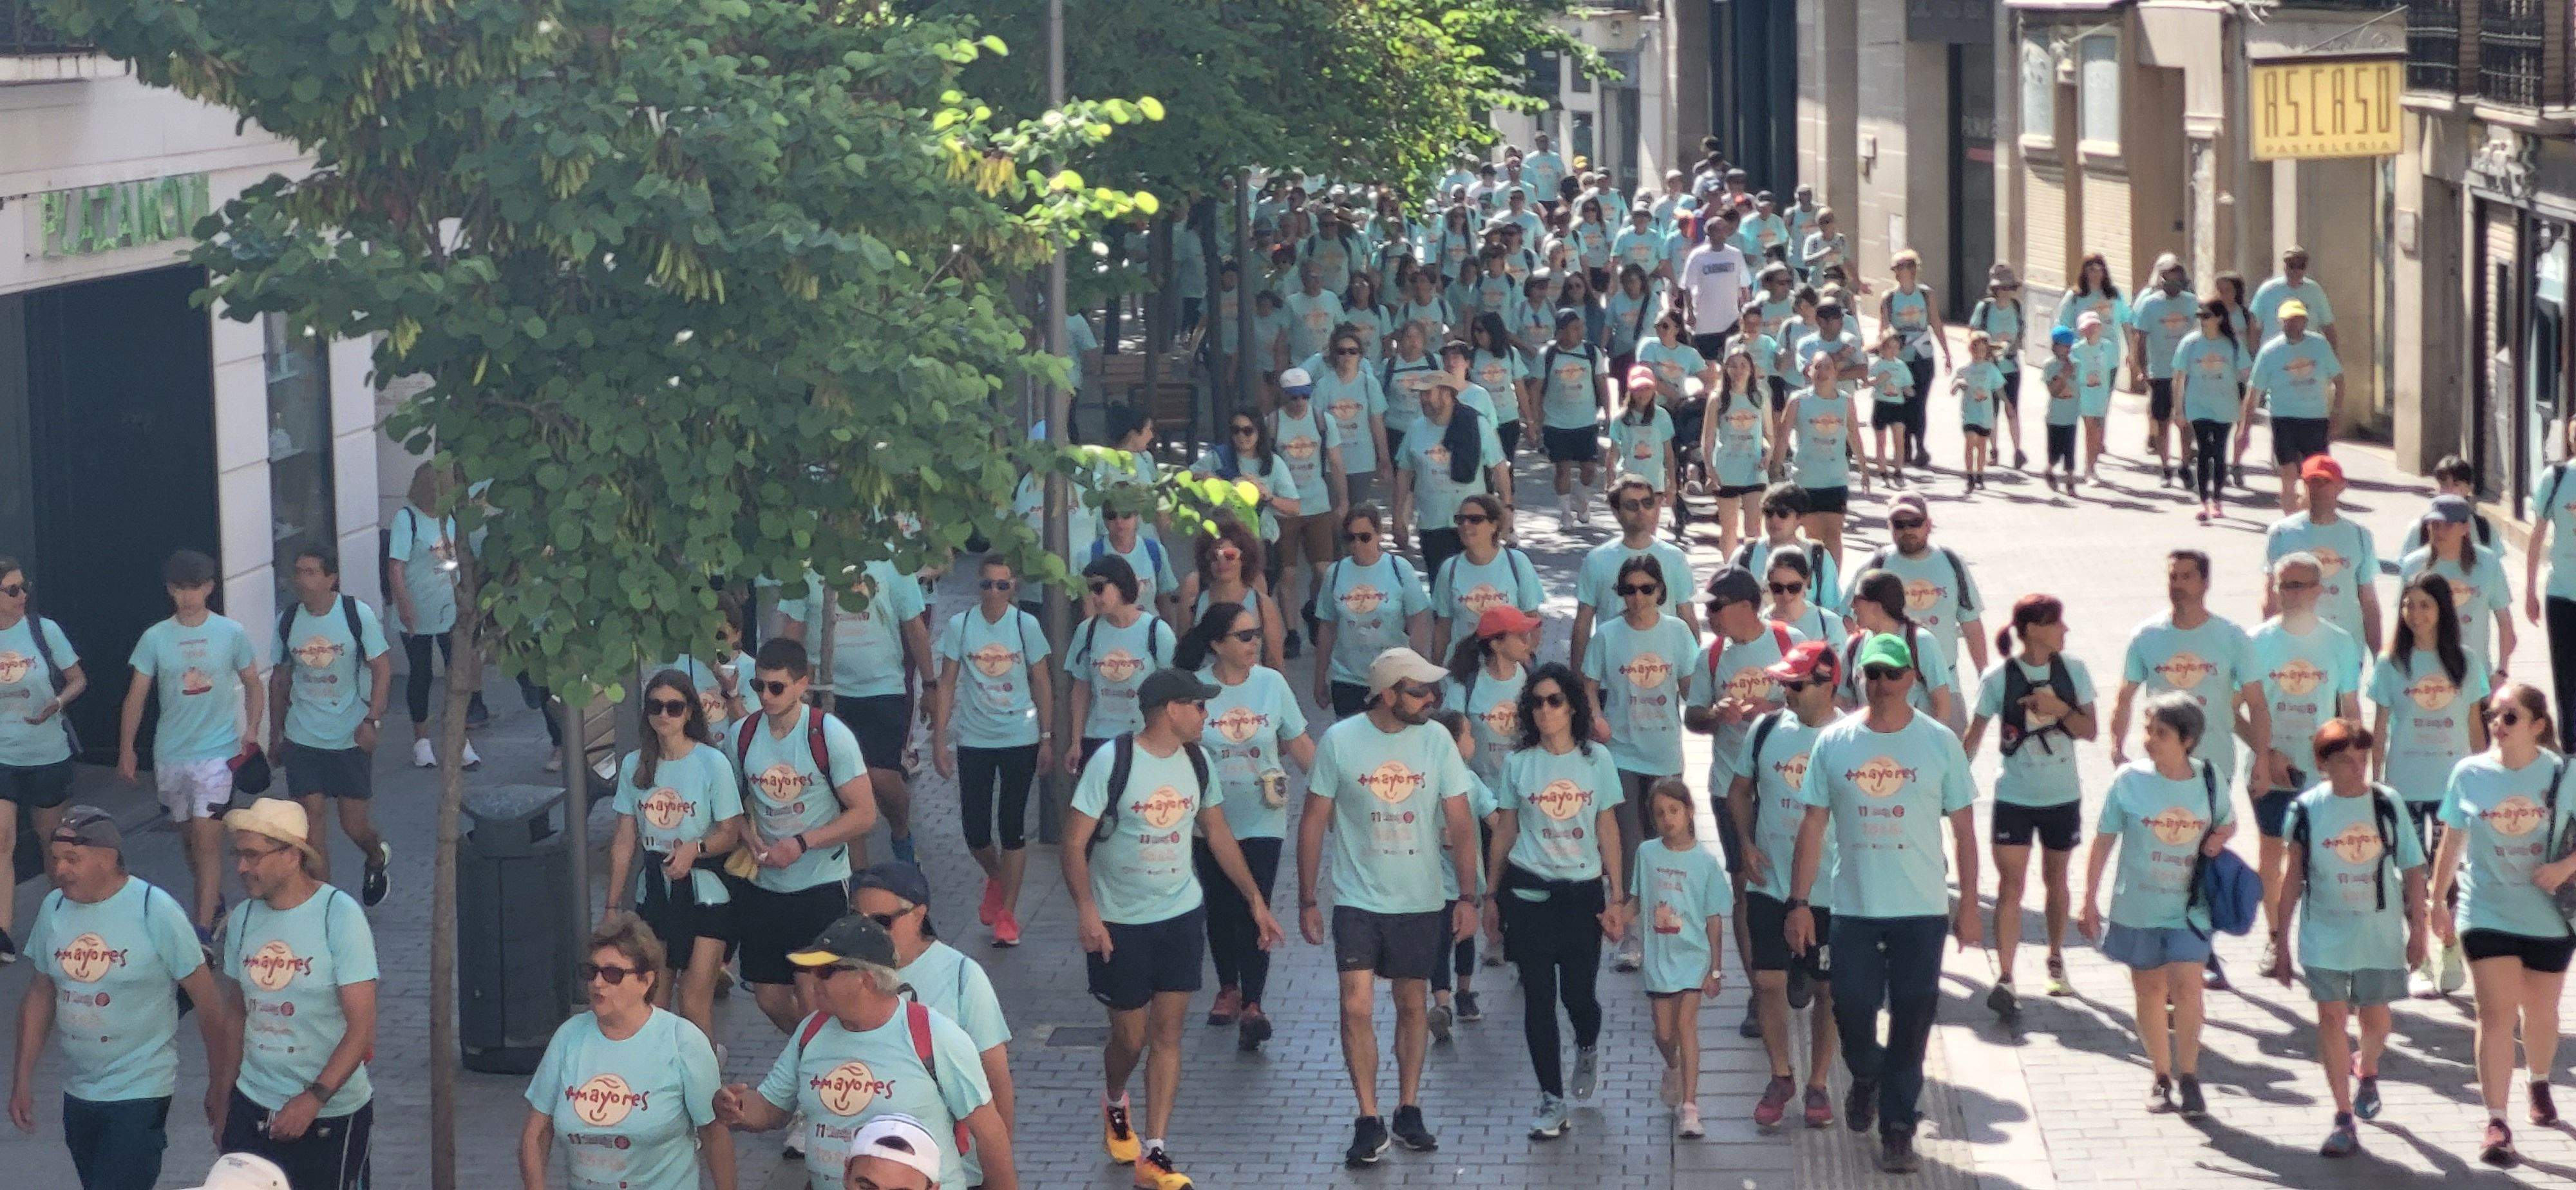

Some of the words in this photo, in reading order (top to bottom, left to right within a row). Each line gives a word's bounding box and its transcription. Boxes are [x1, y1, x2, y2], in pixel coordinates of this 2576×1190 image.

[2264, 66, 2391, 137] ASCASO
[54, 948, 128, 971] +mayores
[242, 954, 314, 978] +mayores
[565, 1084, 650, 1114] +mayores
[810, 1075, 896, 1102] +mayores
